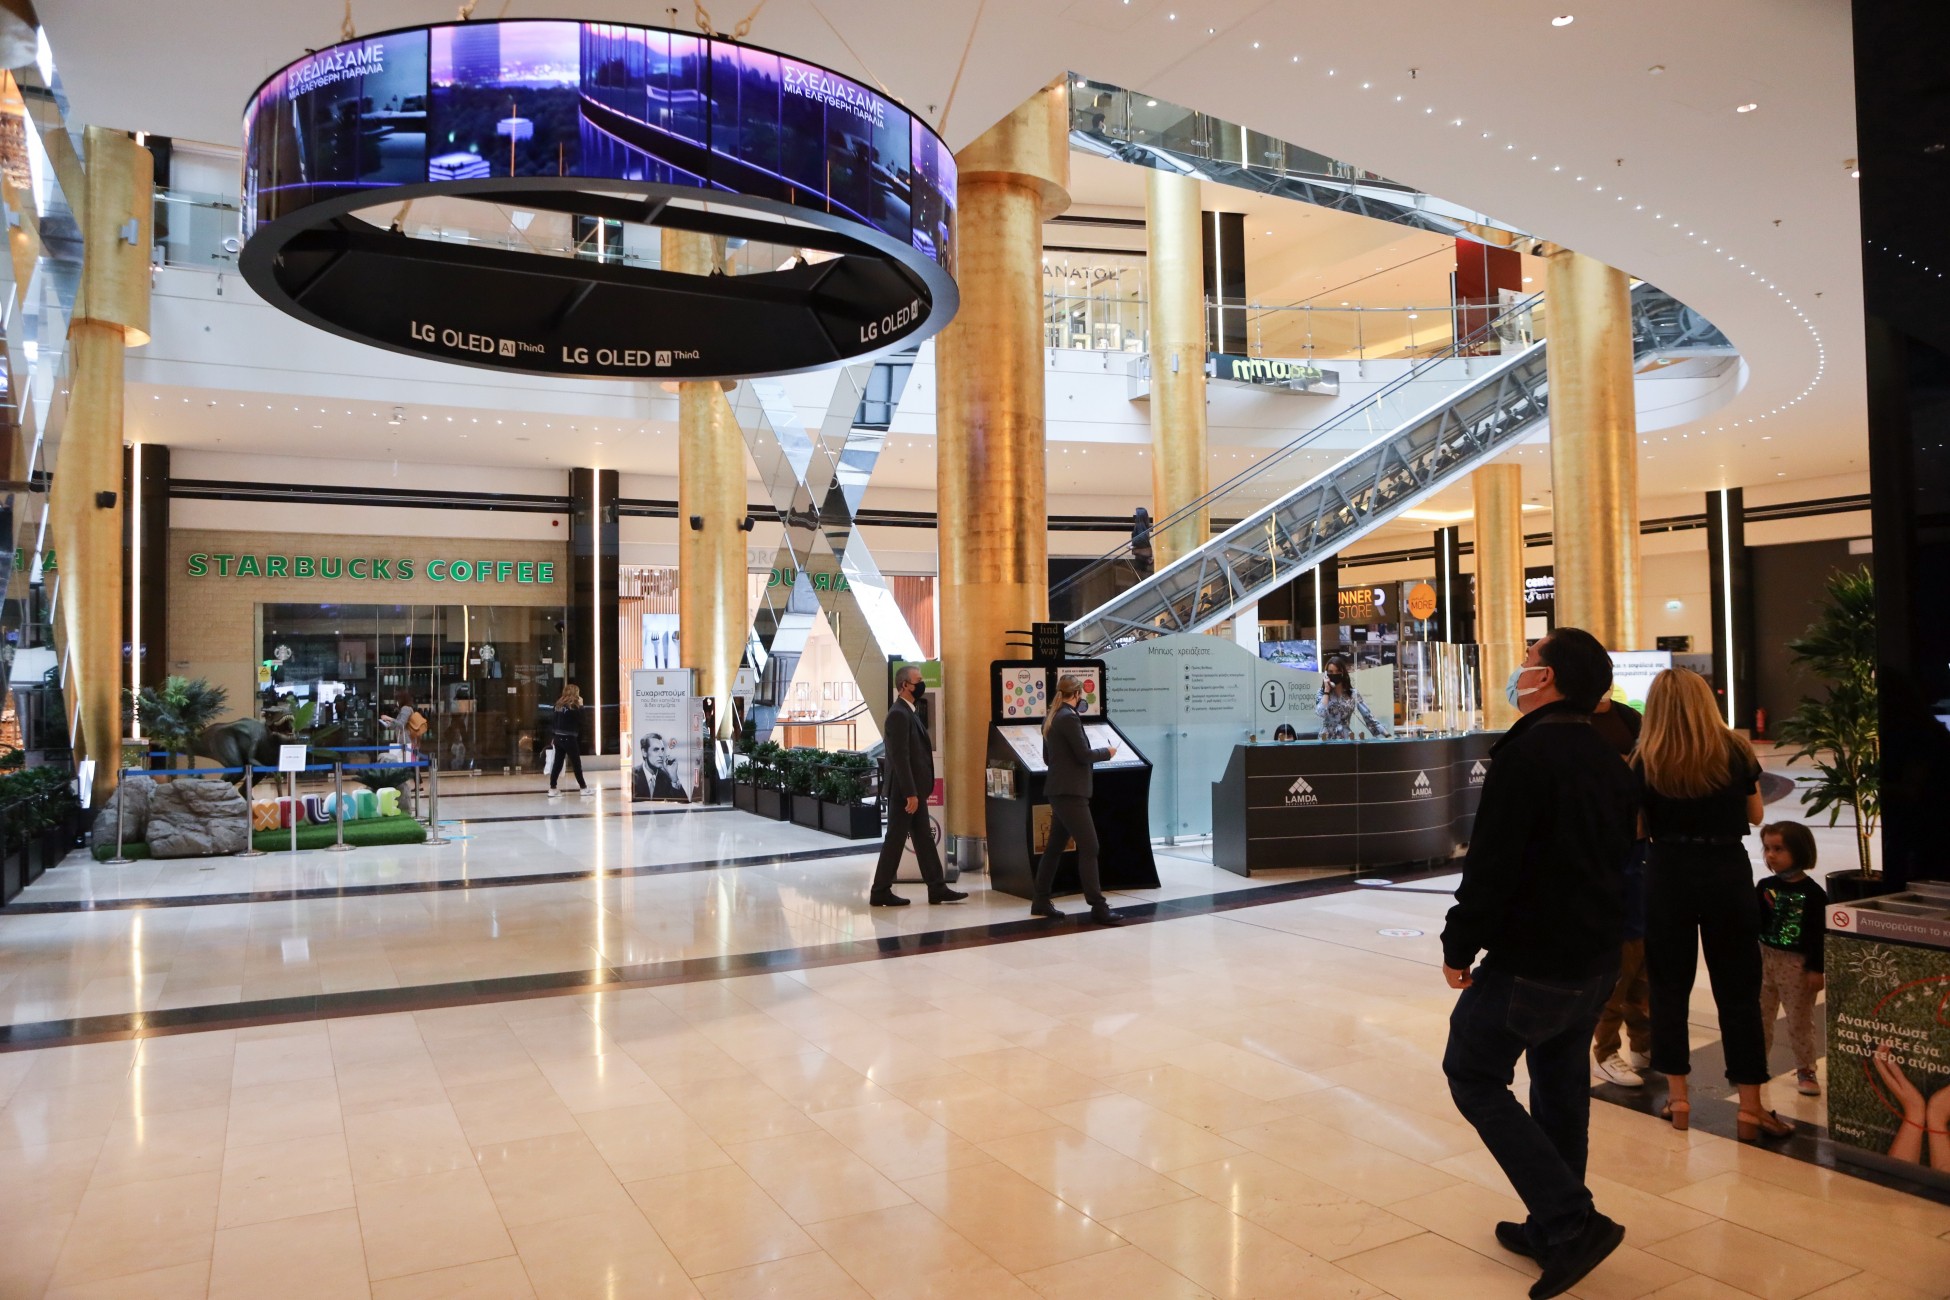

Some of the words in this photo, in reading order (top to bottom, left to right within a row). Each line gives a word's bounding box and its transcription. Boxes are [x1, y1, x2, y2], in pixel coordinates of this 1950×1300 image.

[289, 44, 384, 90] ΣΧΕΔΙΑΣΑΜΕ
[342, 63, 383, 80] ΠΑΡΑΛΙΑ
[784, 65, 884, 119] ΣΧΕΔΙΑΣΑΜΕ
[784, 82, 803, 96] ΜΙΑ
[805, 88, 852, 113] ΕΛΕΥΘΕΡΗ
[853, 106, 884, 130] ΠΑΡΑΛΙΑ
[860, 322, 878, 343] LG
[881, 306, 910, 335] OLED
[411, 321, 435, 343] LG
[442, 329, 494, 354] OLED
[500, 340, 515, 356] AI
[517, 341, 545, 354] ThinQ
[562, 346, 588, 364] LG
[596, 349, 650, 366] OLED
[656, 351, 671, 366] AI
[674, 350, 700, 360] ThinQ
[188, 552, 415, 581] STARBUCKS
[426, 559, 555, 583] COFFEE
[1526, 575, 1554, 588] cente
[1411, 599, 1432, 610] MORE
[1536, 592, 1554, 601] GIFT
[1339, 603, 1372, 619] STORE
[1040, 623, 1058, 634] find
[1040, 637, 1059, 648] your
[1041, 647, 1058, 659] way
[1148, 646, 1174, 656] Μήπως
[636, 688, 686, 698] Ευχαριστούμε
[1288, 702, 1299, 711] Info
[1468, 775, 1485, 784] LAMD
[1285, 794, 1318, 804] LAMDA
[1412, 787, 1433, 796] LAMDA
[252, 787, 401, 832] XPLORE
[1860, 917, 1927, 934] Απαγορεύεται
[1930, 928, 1941, 936] το
[1838, 1012, 1929, 1040] Ανακύκλωσε
[1838, 1028, 1859, 1041] και
[1862, 1032, 1910, 1053] φτιάξε
[1913, 1041, 1941, 1058] ένα
[1839, 1042, 1905, 1065] καλύτερο
[1836, 1123, 1866, 1138] Ready?
